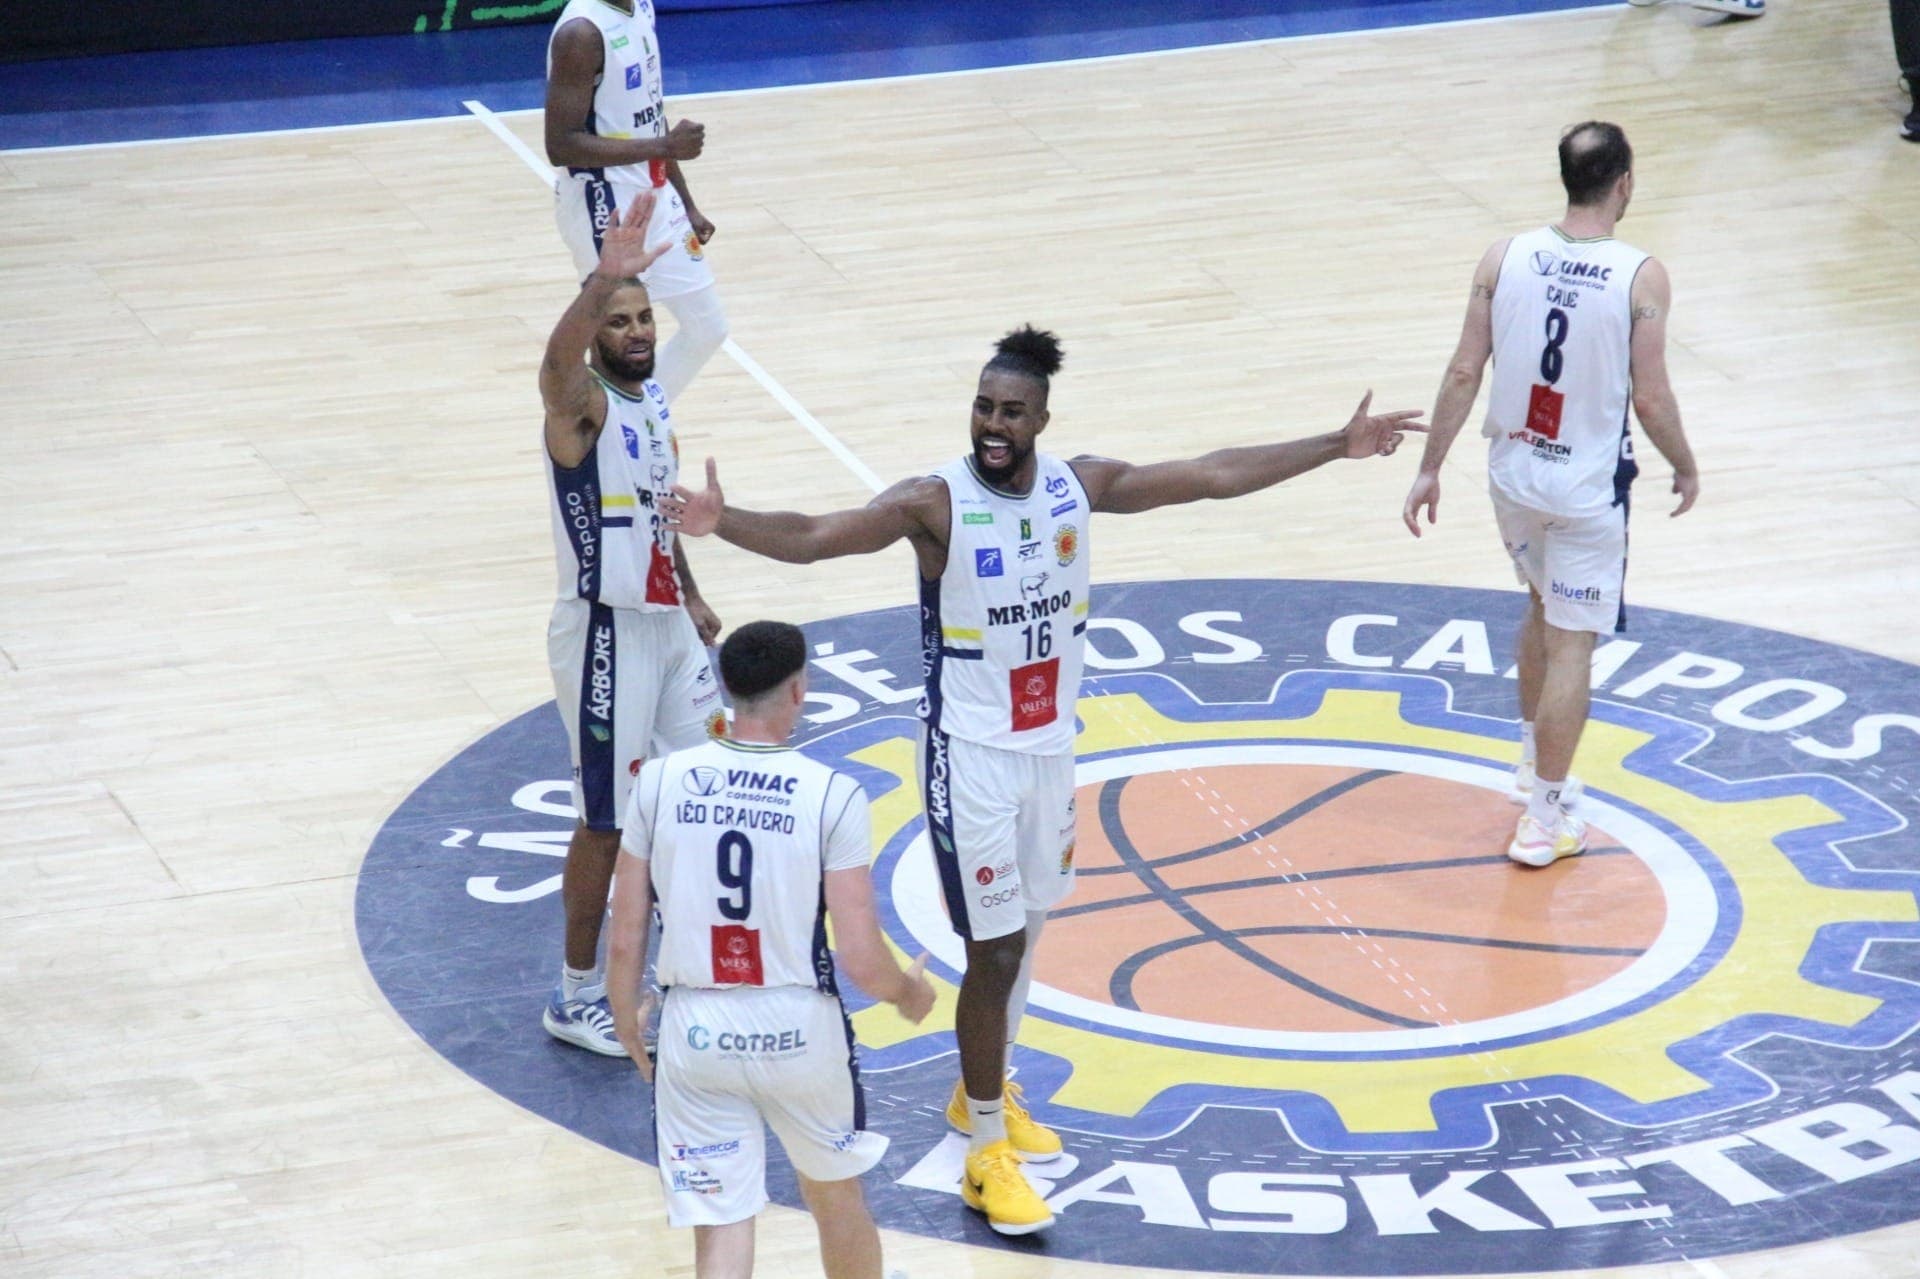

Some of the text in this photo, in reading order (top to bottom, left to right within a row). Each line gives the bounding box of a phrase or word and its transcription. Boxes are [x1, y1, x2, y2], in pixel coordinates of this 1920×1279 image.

[1540, 307, 1569, 385] 8
[1551, 579, 1601, 601] bluefit
[1022, 620, 1052, 660] 16
[1083, 611, 1263, 670] OS
[728, 769, 799, 795] VINAC
[713, 805, 795, 835] CRAVERO
[716, 829, 753, 921] 9
[718, 1029, 807, 1052] COTREL
